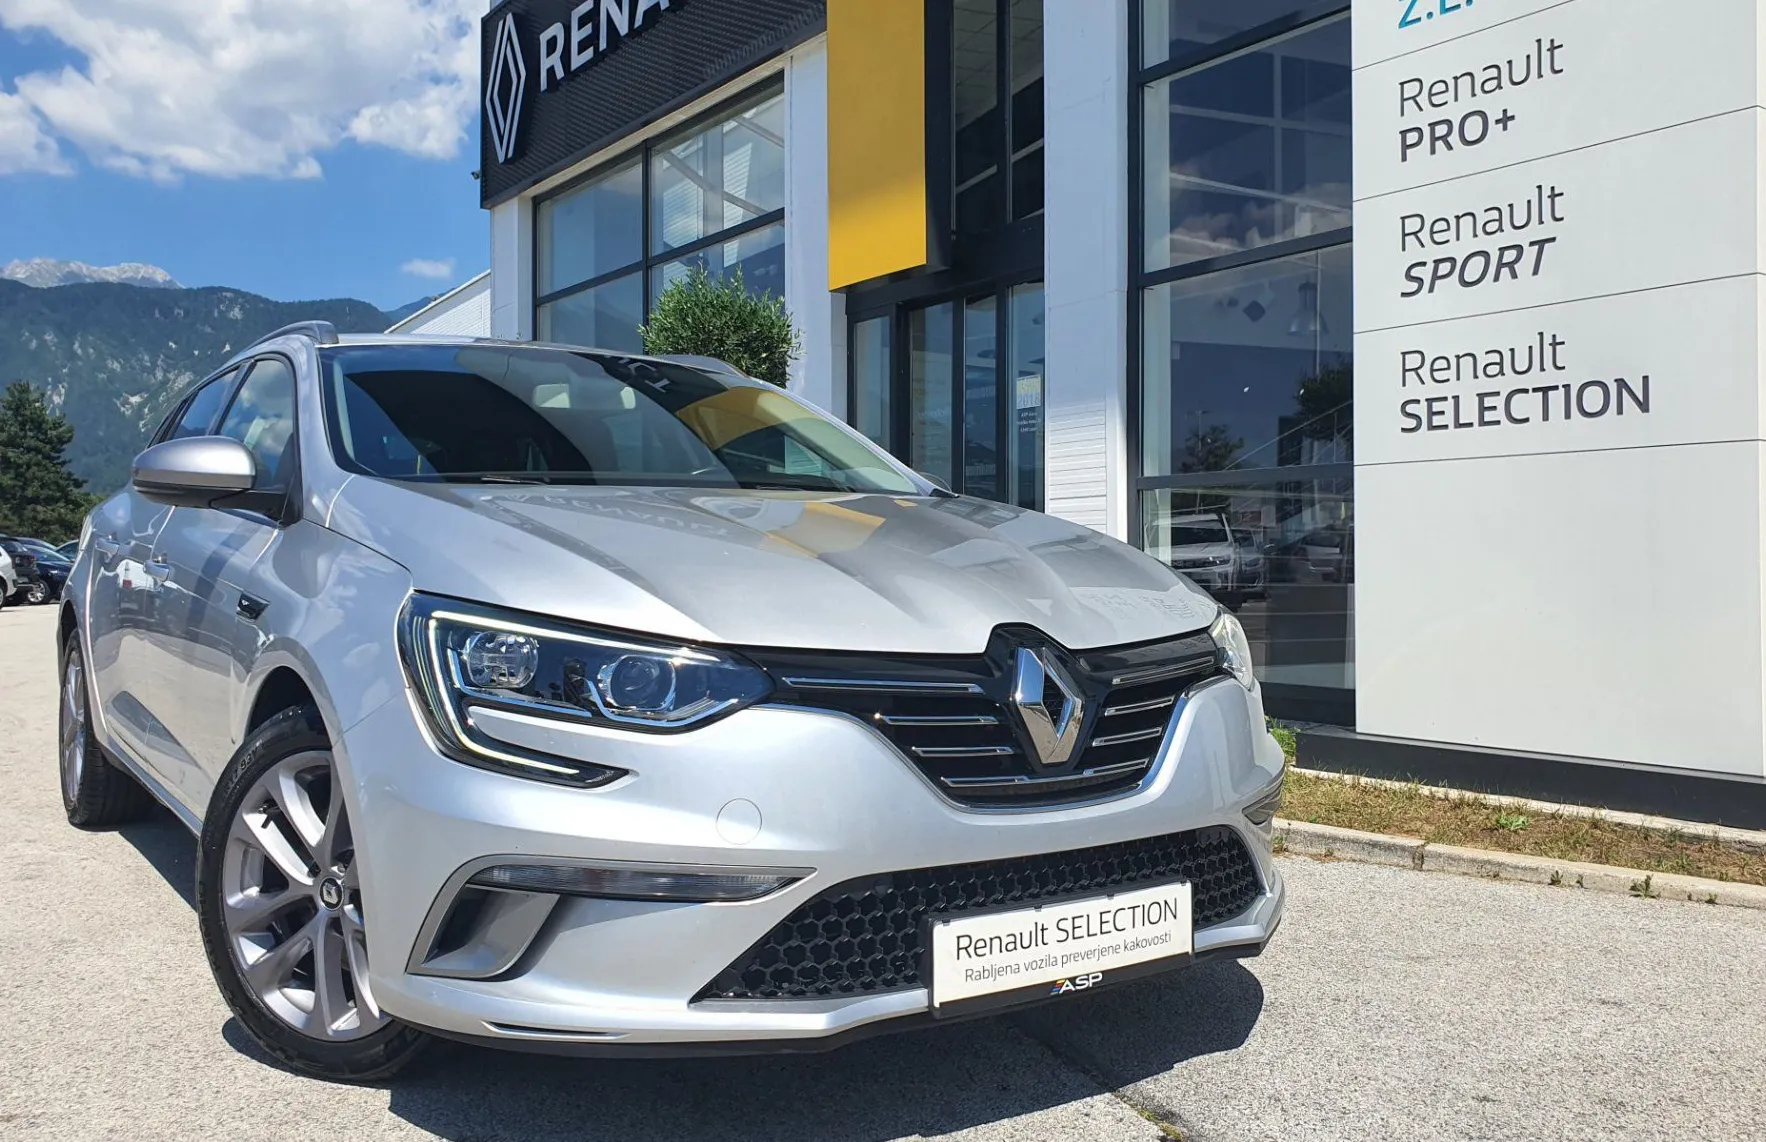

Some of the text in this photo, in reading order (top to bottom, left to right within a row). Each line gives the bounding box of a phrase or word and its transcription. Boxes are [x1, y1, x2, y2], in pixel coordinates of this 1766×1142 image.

[1399, 38, 1563, 117] Renault
[1399, 108, 1516, 163] PRO+
[1400, 185, 1565, 252] Renault
[1400, 236, 1557, 298] SPORT
[1401, 332, 1566, 388] Renault
[1400, 375, 1650, 434] SELECTION
[956, 898, 1178, 961] Renault SELECTION
[965, 930, 1172, 982] Rabljena vozila preverjene kakovosti
[1057, 972, 1103, 995] ASP
